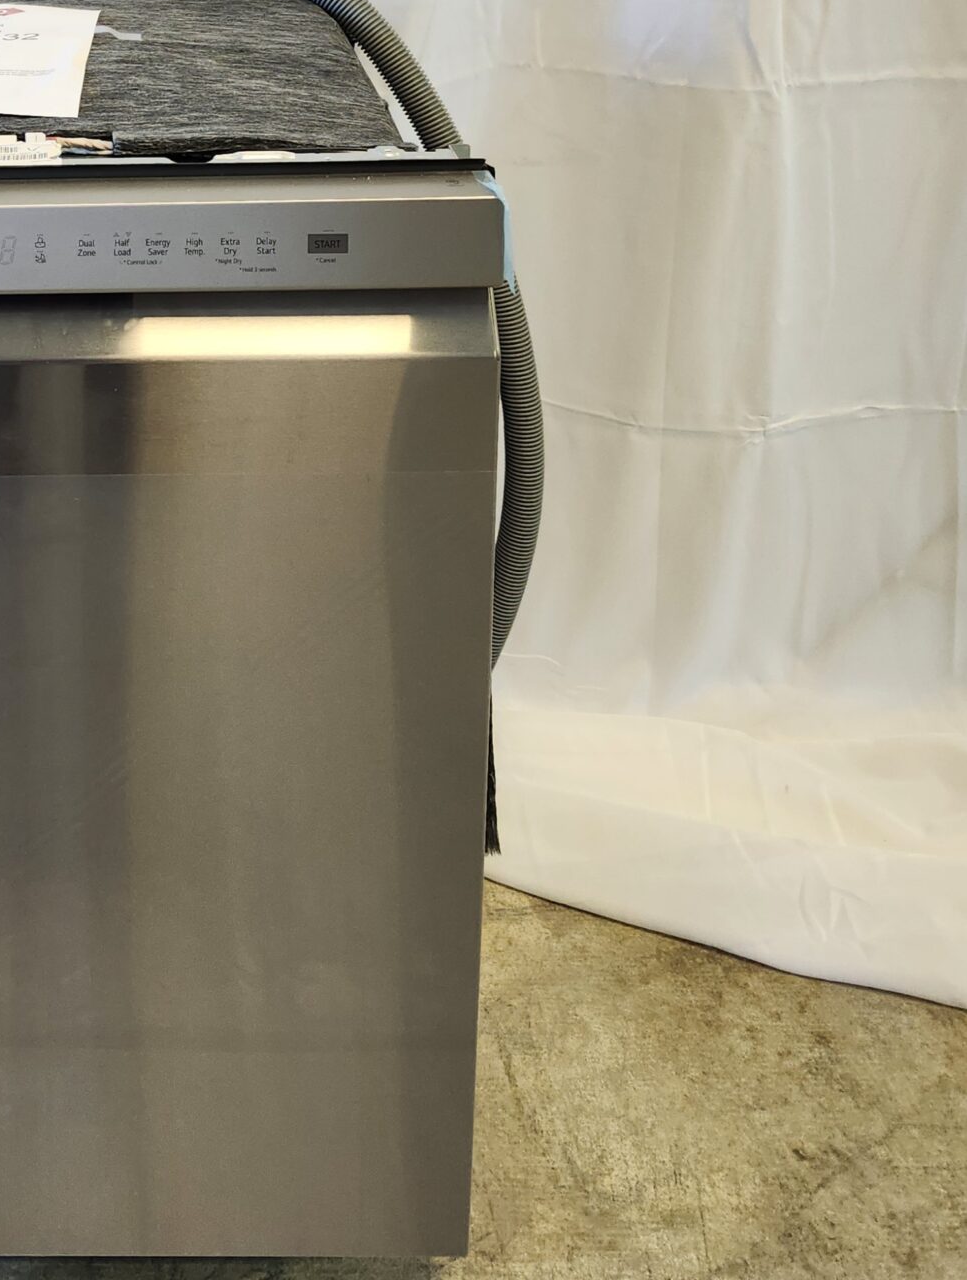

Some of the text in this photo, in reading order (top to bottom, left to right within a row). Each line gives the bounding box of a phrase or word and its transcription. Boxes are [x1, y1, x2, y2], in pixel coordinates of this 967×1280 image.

[78, 239, 95, 248] Dual
[114, 239, 130, 247] Half
[145, 238, 171, 248] Energy
[186, 238, 203, 247] High
[220, 237, 240, 246] Extra
[256, 237, 277, 247] Delay
[314, 239, 341, 251] START
[77, 248, 97, 257] Zone
[113, 248, 132, 257] Load
[147, 248, 168, 256] Saver
[184, 248, 205, 257] Temp.
[224, 247, 237, 257] Dry
[256, 247, 276, 255] Start
